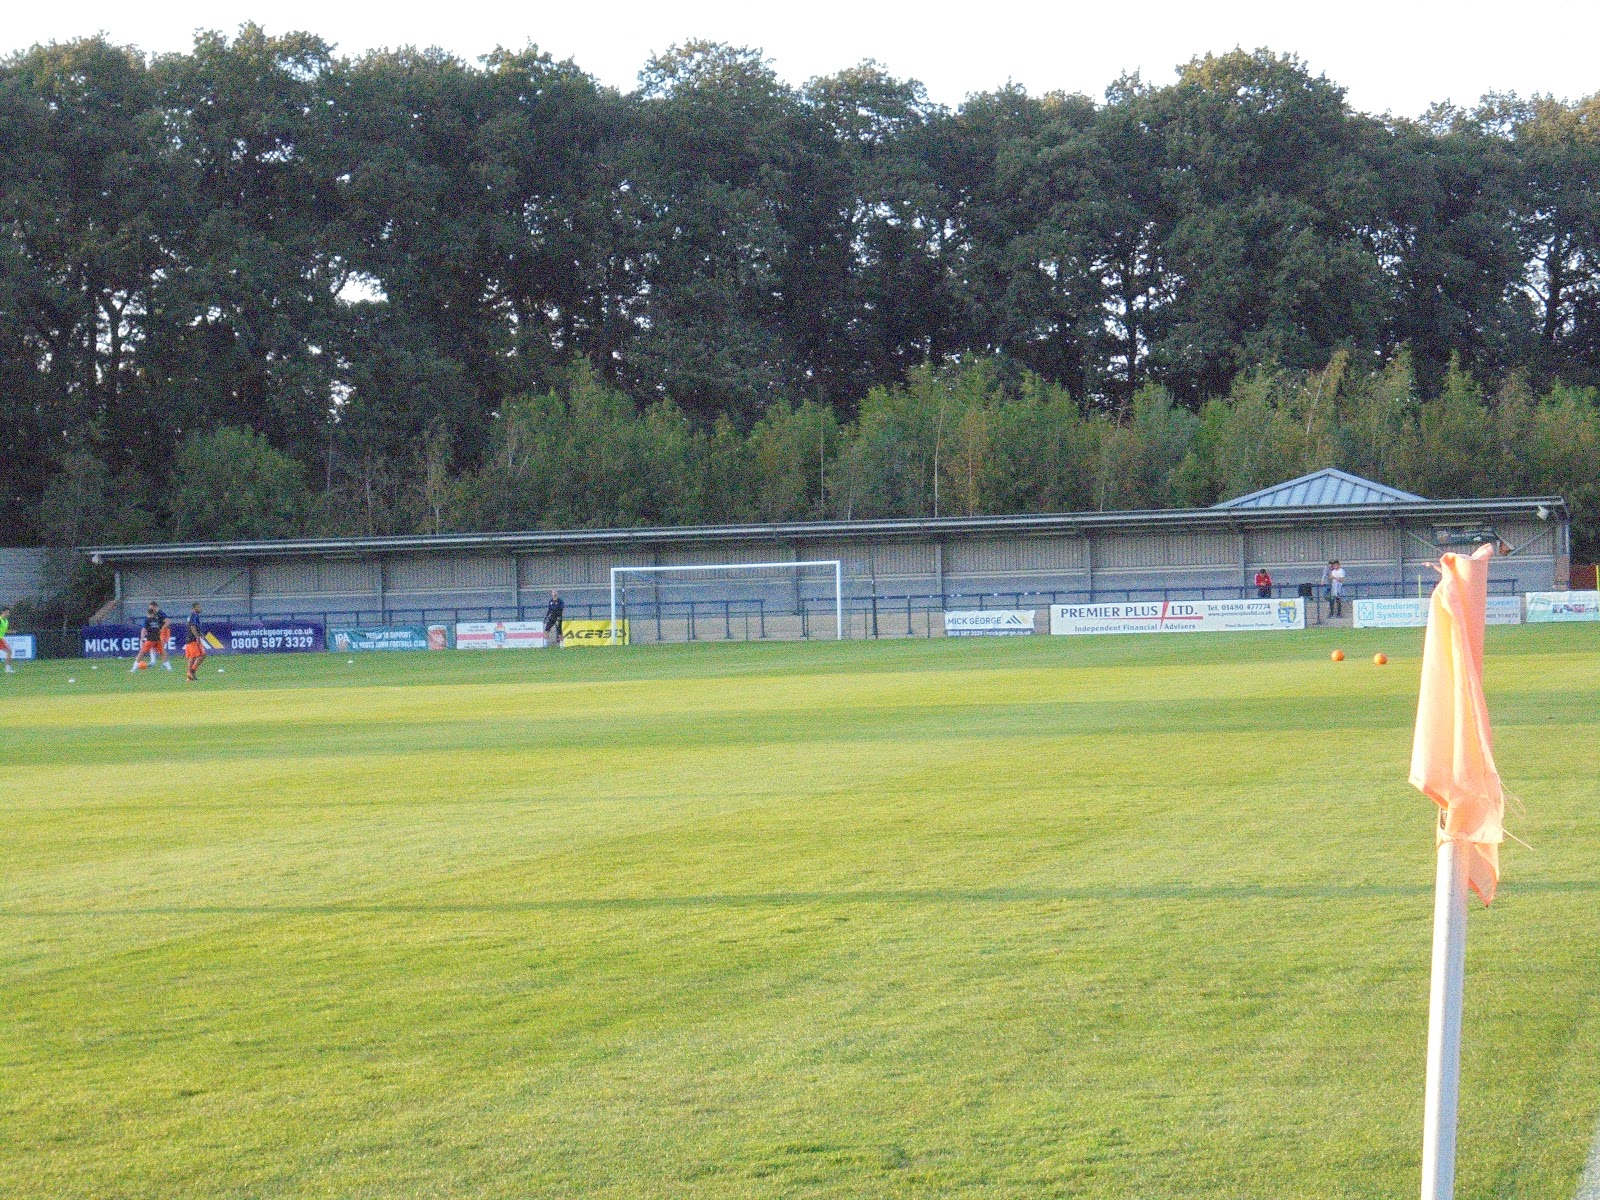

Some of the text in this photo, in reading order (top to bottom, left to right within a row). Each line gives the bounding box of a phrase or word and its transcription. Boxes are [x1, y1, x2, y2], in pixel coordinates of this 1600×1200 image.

[1060, 605, 1198, 618] PREMIER PLUS LTD.
[231, 628, 314, 636] www.mickgeorge.co.uk
[85, 638, 119, 652] MICK
[231, 637, 314, 649] 0800 587 3329
[334, 633, 351, 646] IPA
